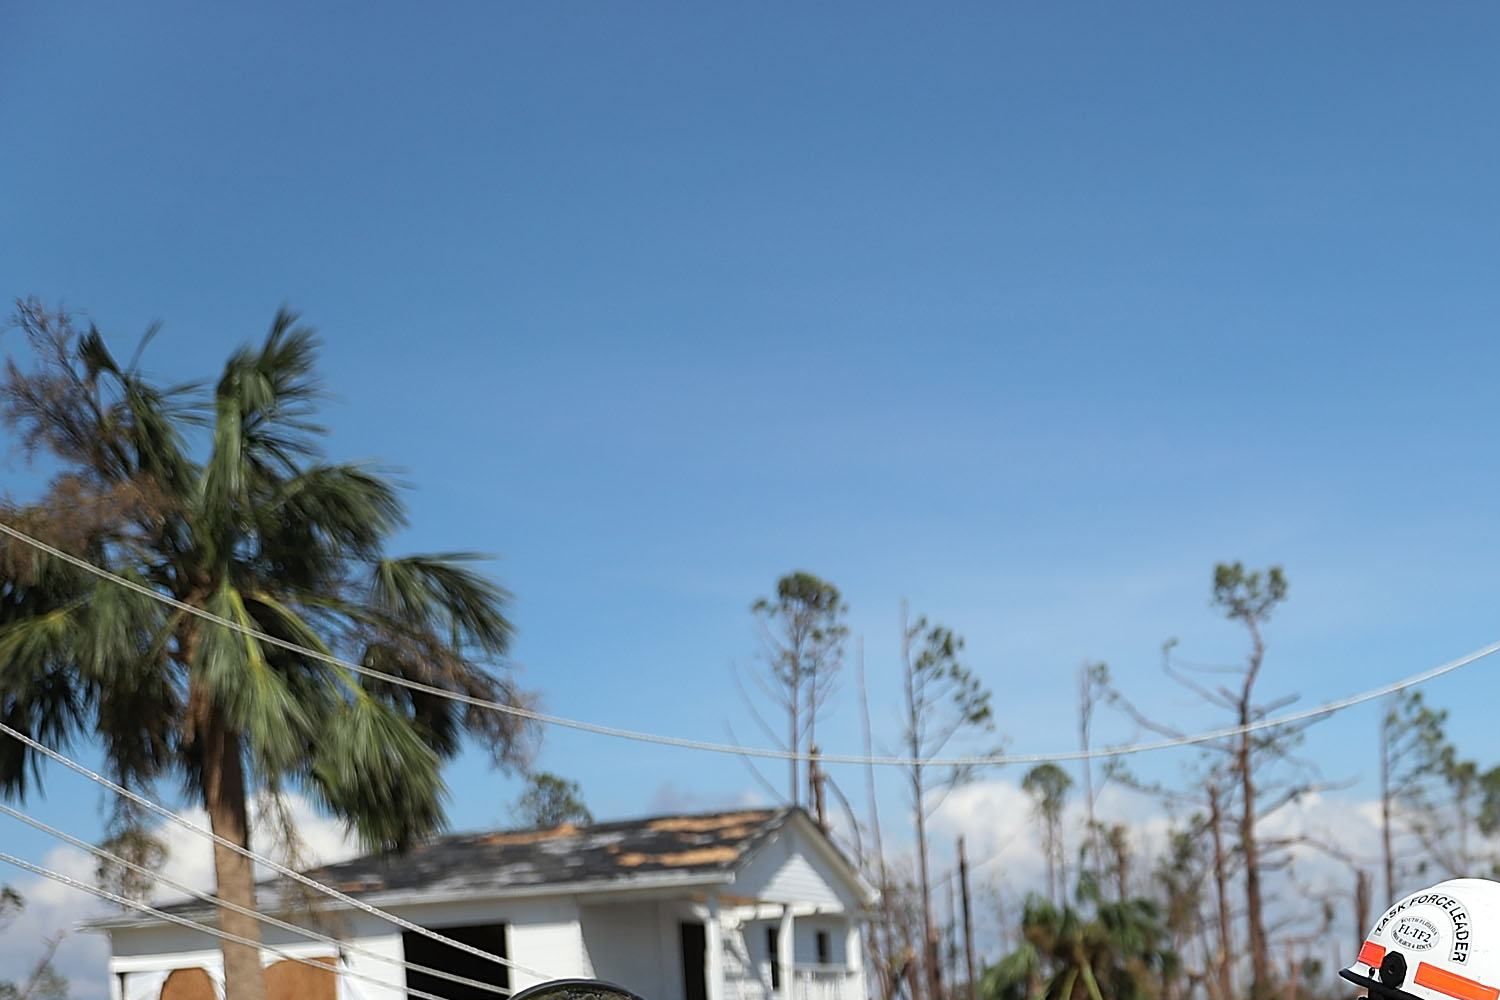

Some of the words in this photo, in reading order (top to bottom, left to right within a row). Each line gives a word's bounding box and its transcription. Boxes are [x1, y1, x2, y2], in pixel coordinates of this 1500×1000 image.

[1375, 903, 1405, 933] TASK
[1409, 894, 1456, 910] FORCE
[1449, 906, 1469, 963] LEADER
